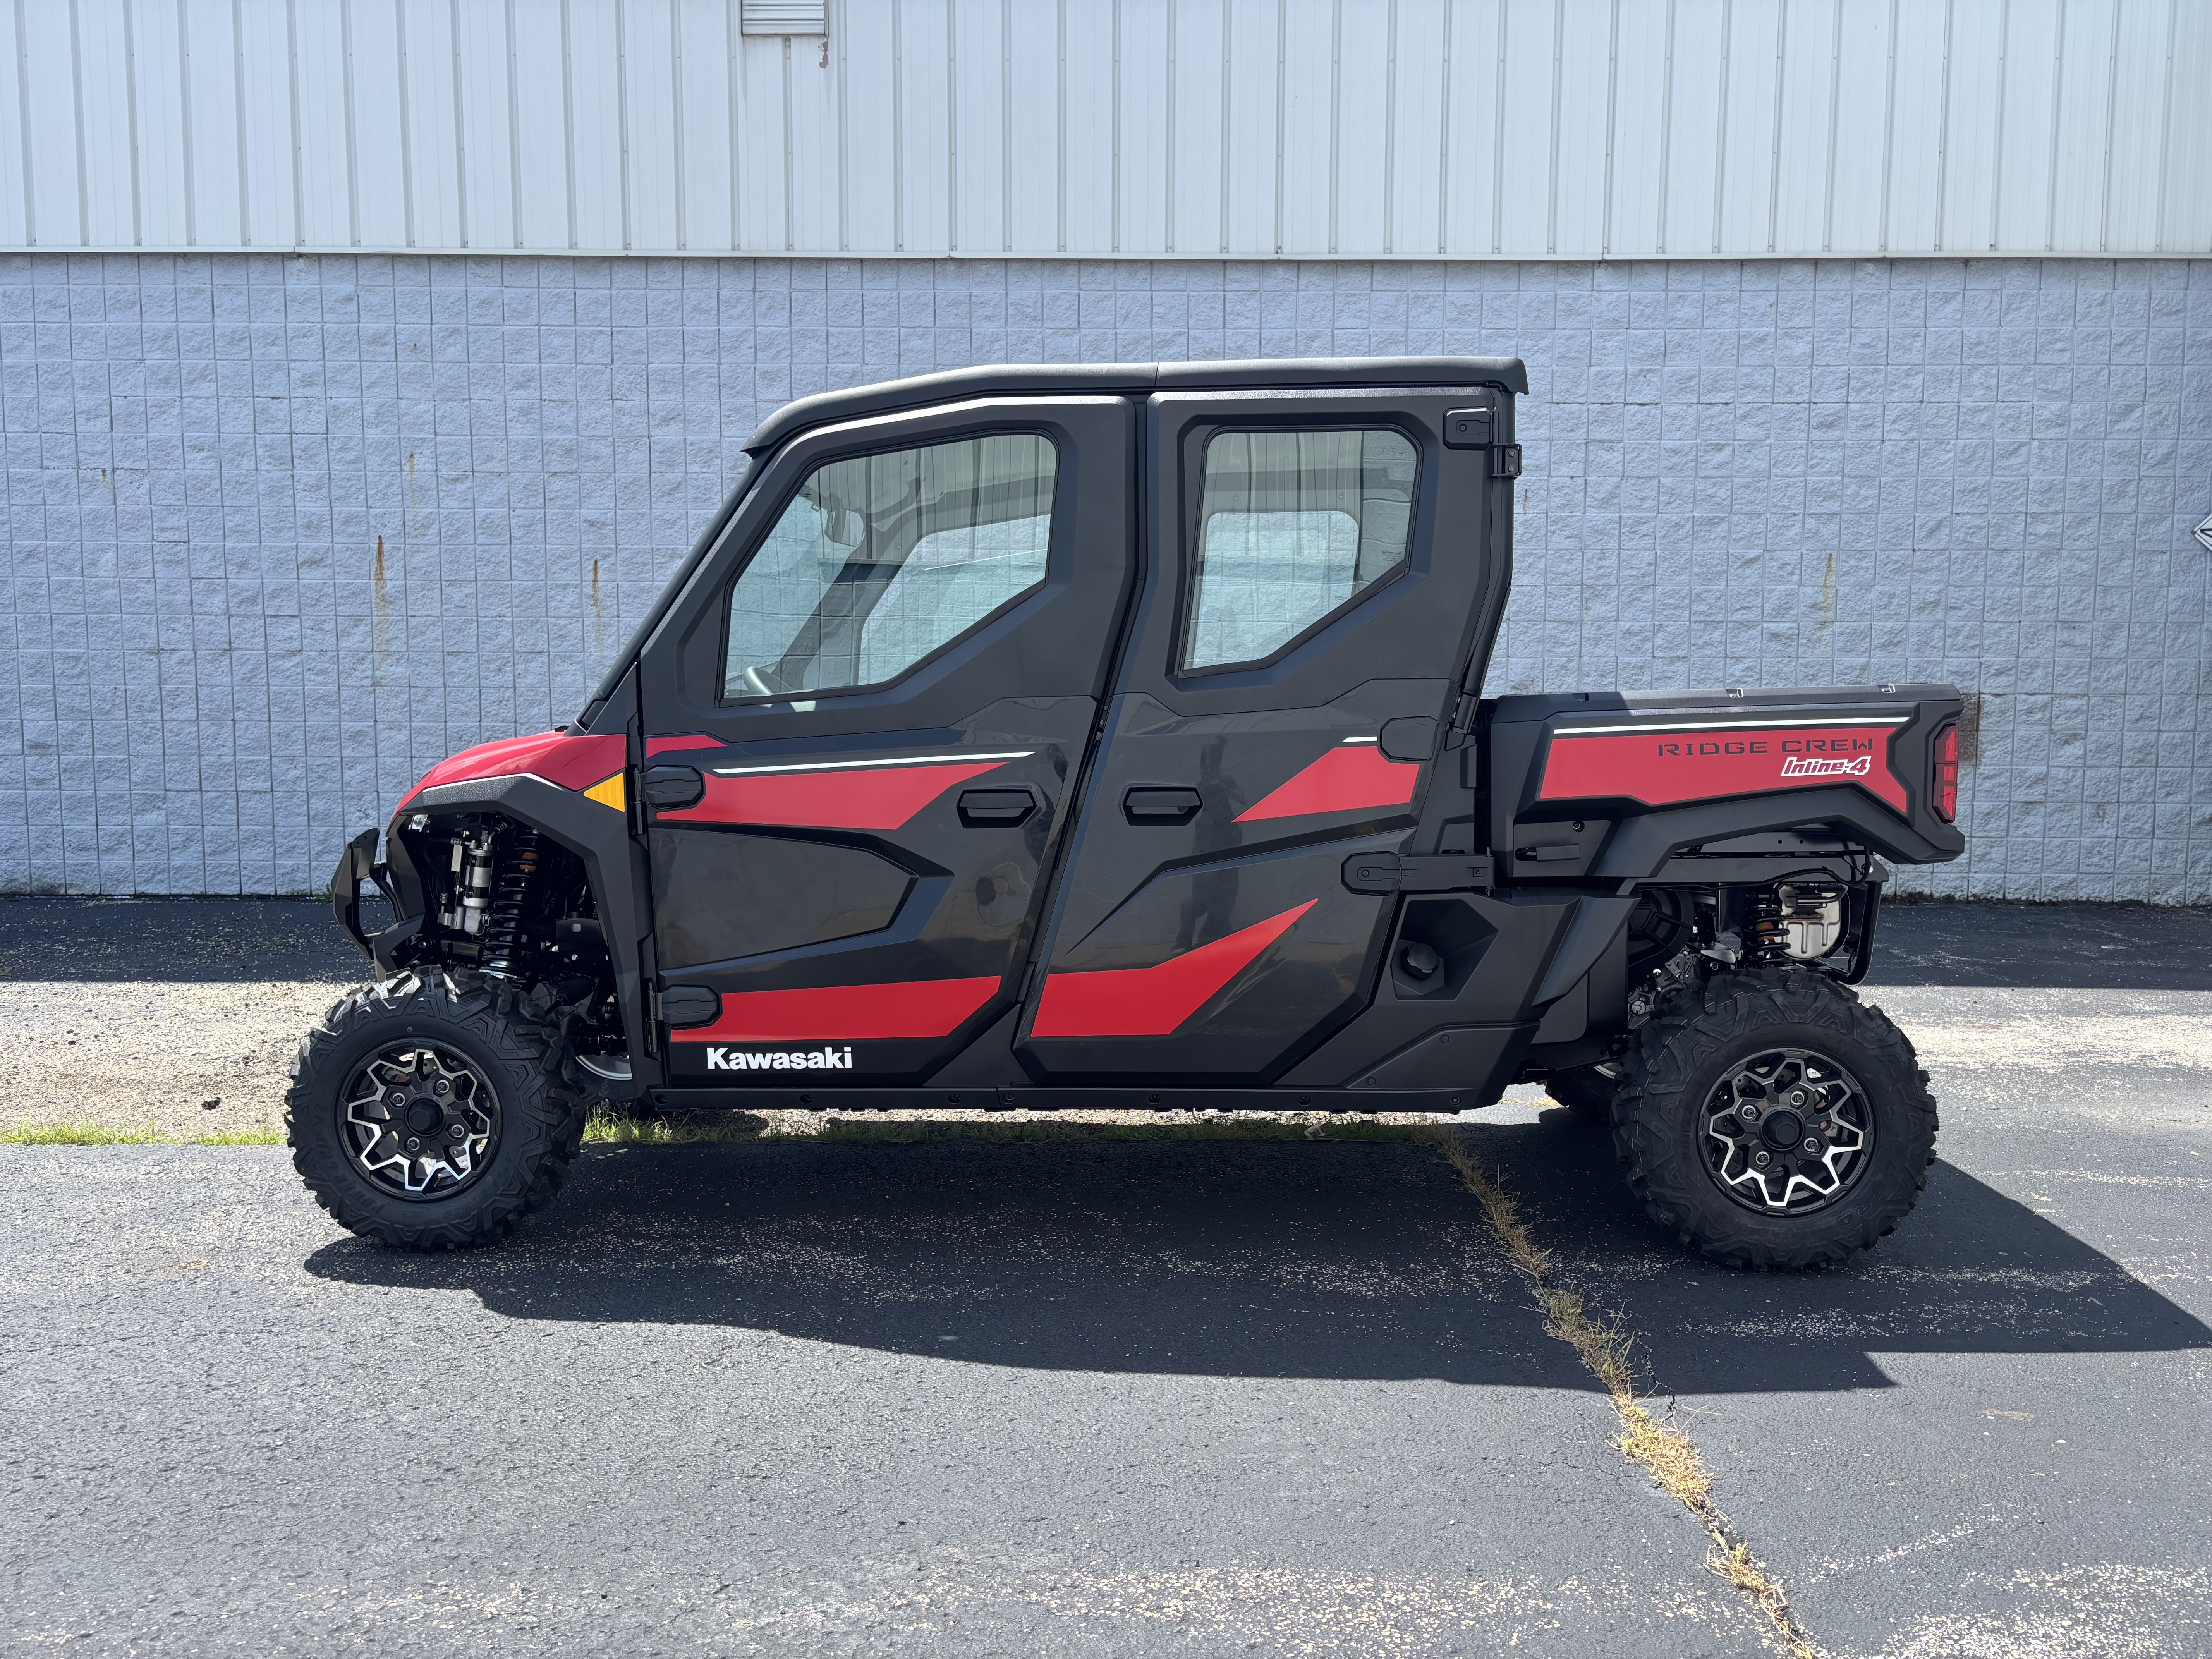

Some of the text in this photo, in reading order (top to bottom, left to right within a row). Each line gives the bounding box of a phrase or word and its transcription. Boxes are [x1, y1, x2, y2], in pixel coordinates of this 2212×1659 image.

[1659, 739, 1872, 756] RIDGE CREW
[1781, 756, 1871, 776] Inline-4
[707, 1047, 852, 1070] Kawasaki
[1838, 1159, 1898, 1229] DURO
